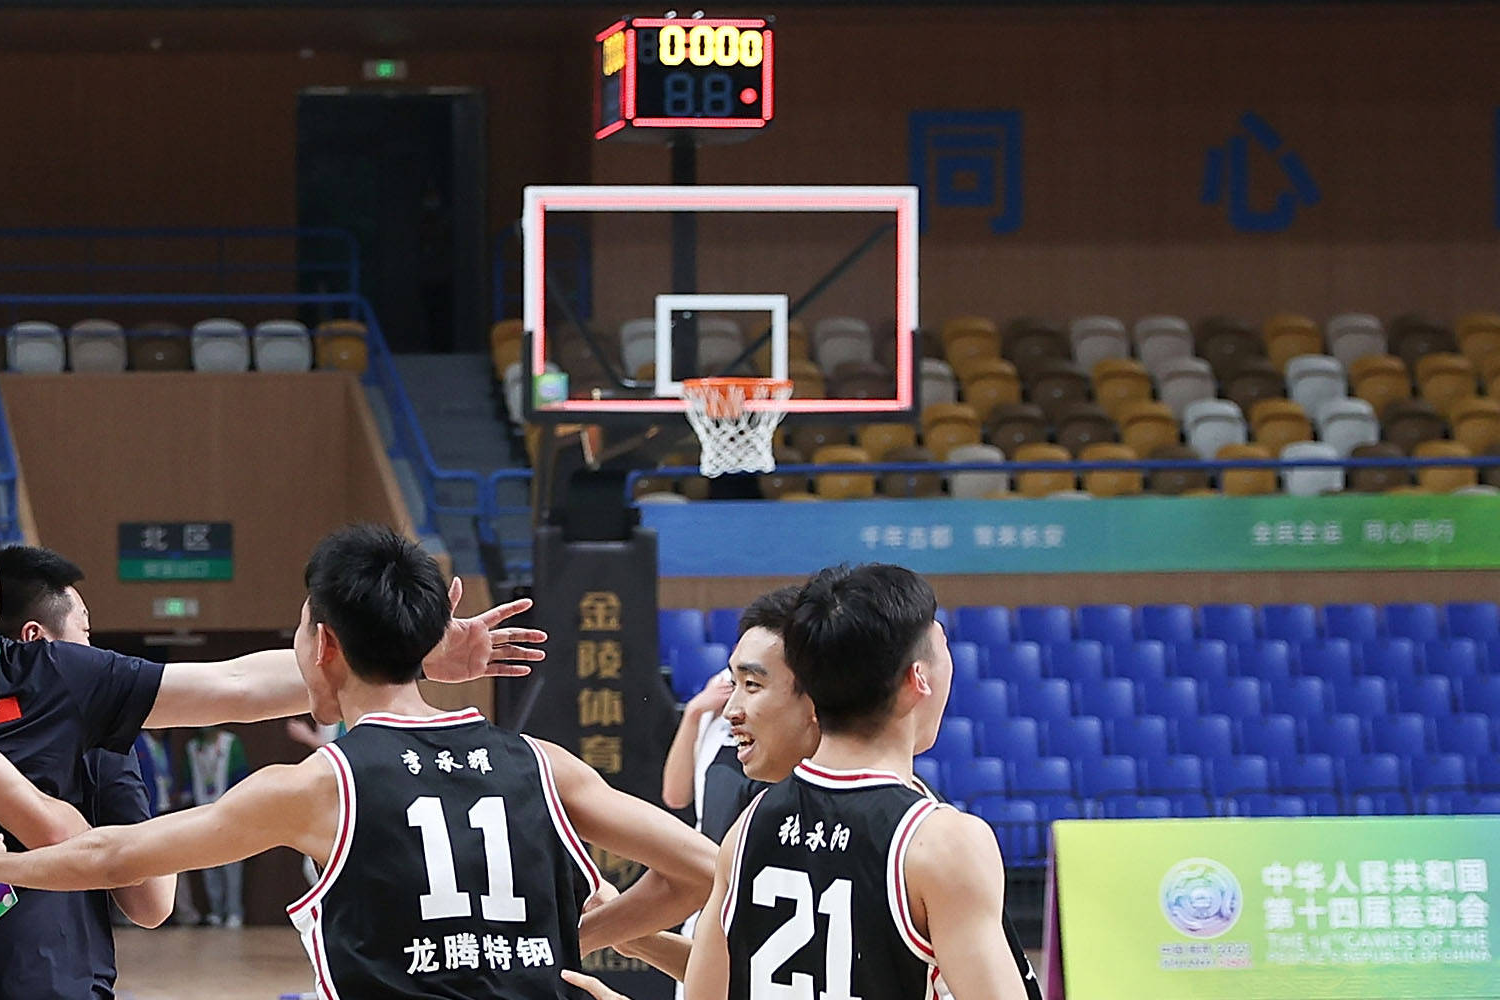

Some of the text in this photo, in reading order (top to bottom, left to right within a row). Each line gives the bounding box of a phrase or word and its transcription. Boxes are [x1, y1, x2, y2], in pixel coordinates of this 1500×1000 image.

[406, 796, 527, 922] 11
[1261, 859, 1489, 894] 中华人民共和国
[1263, 893, 1490, 929] 第十四届运动会
[403, 932, 555, 975] 龙腾特钢
